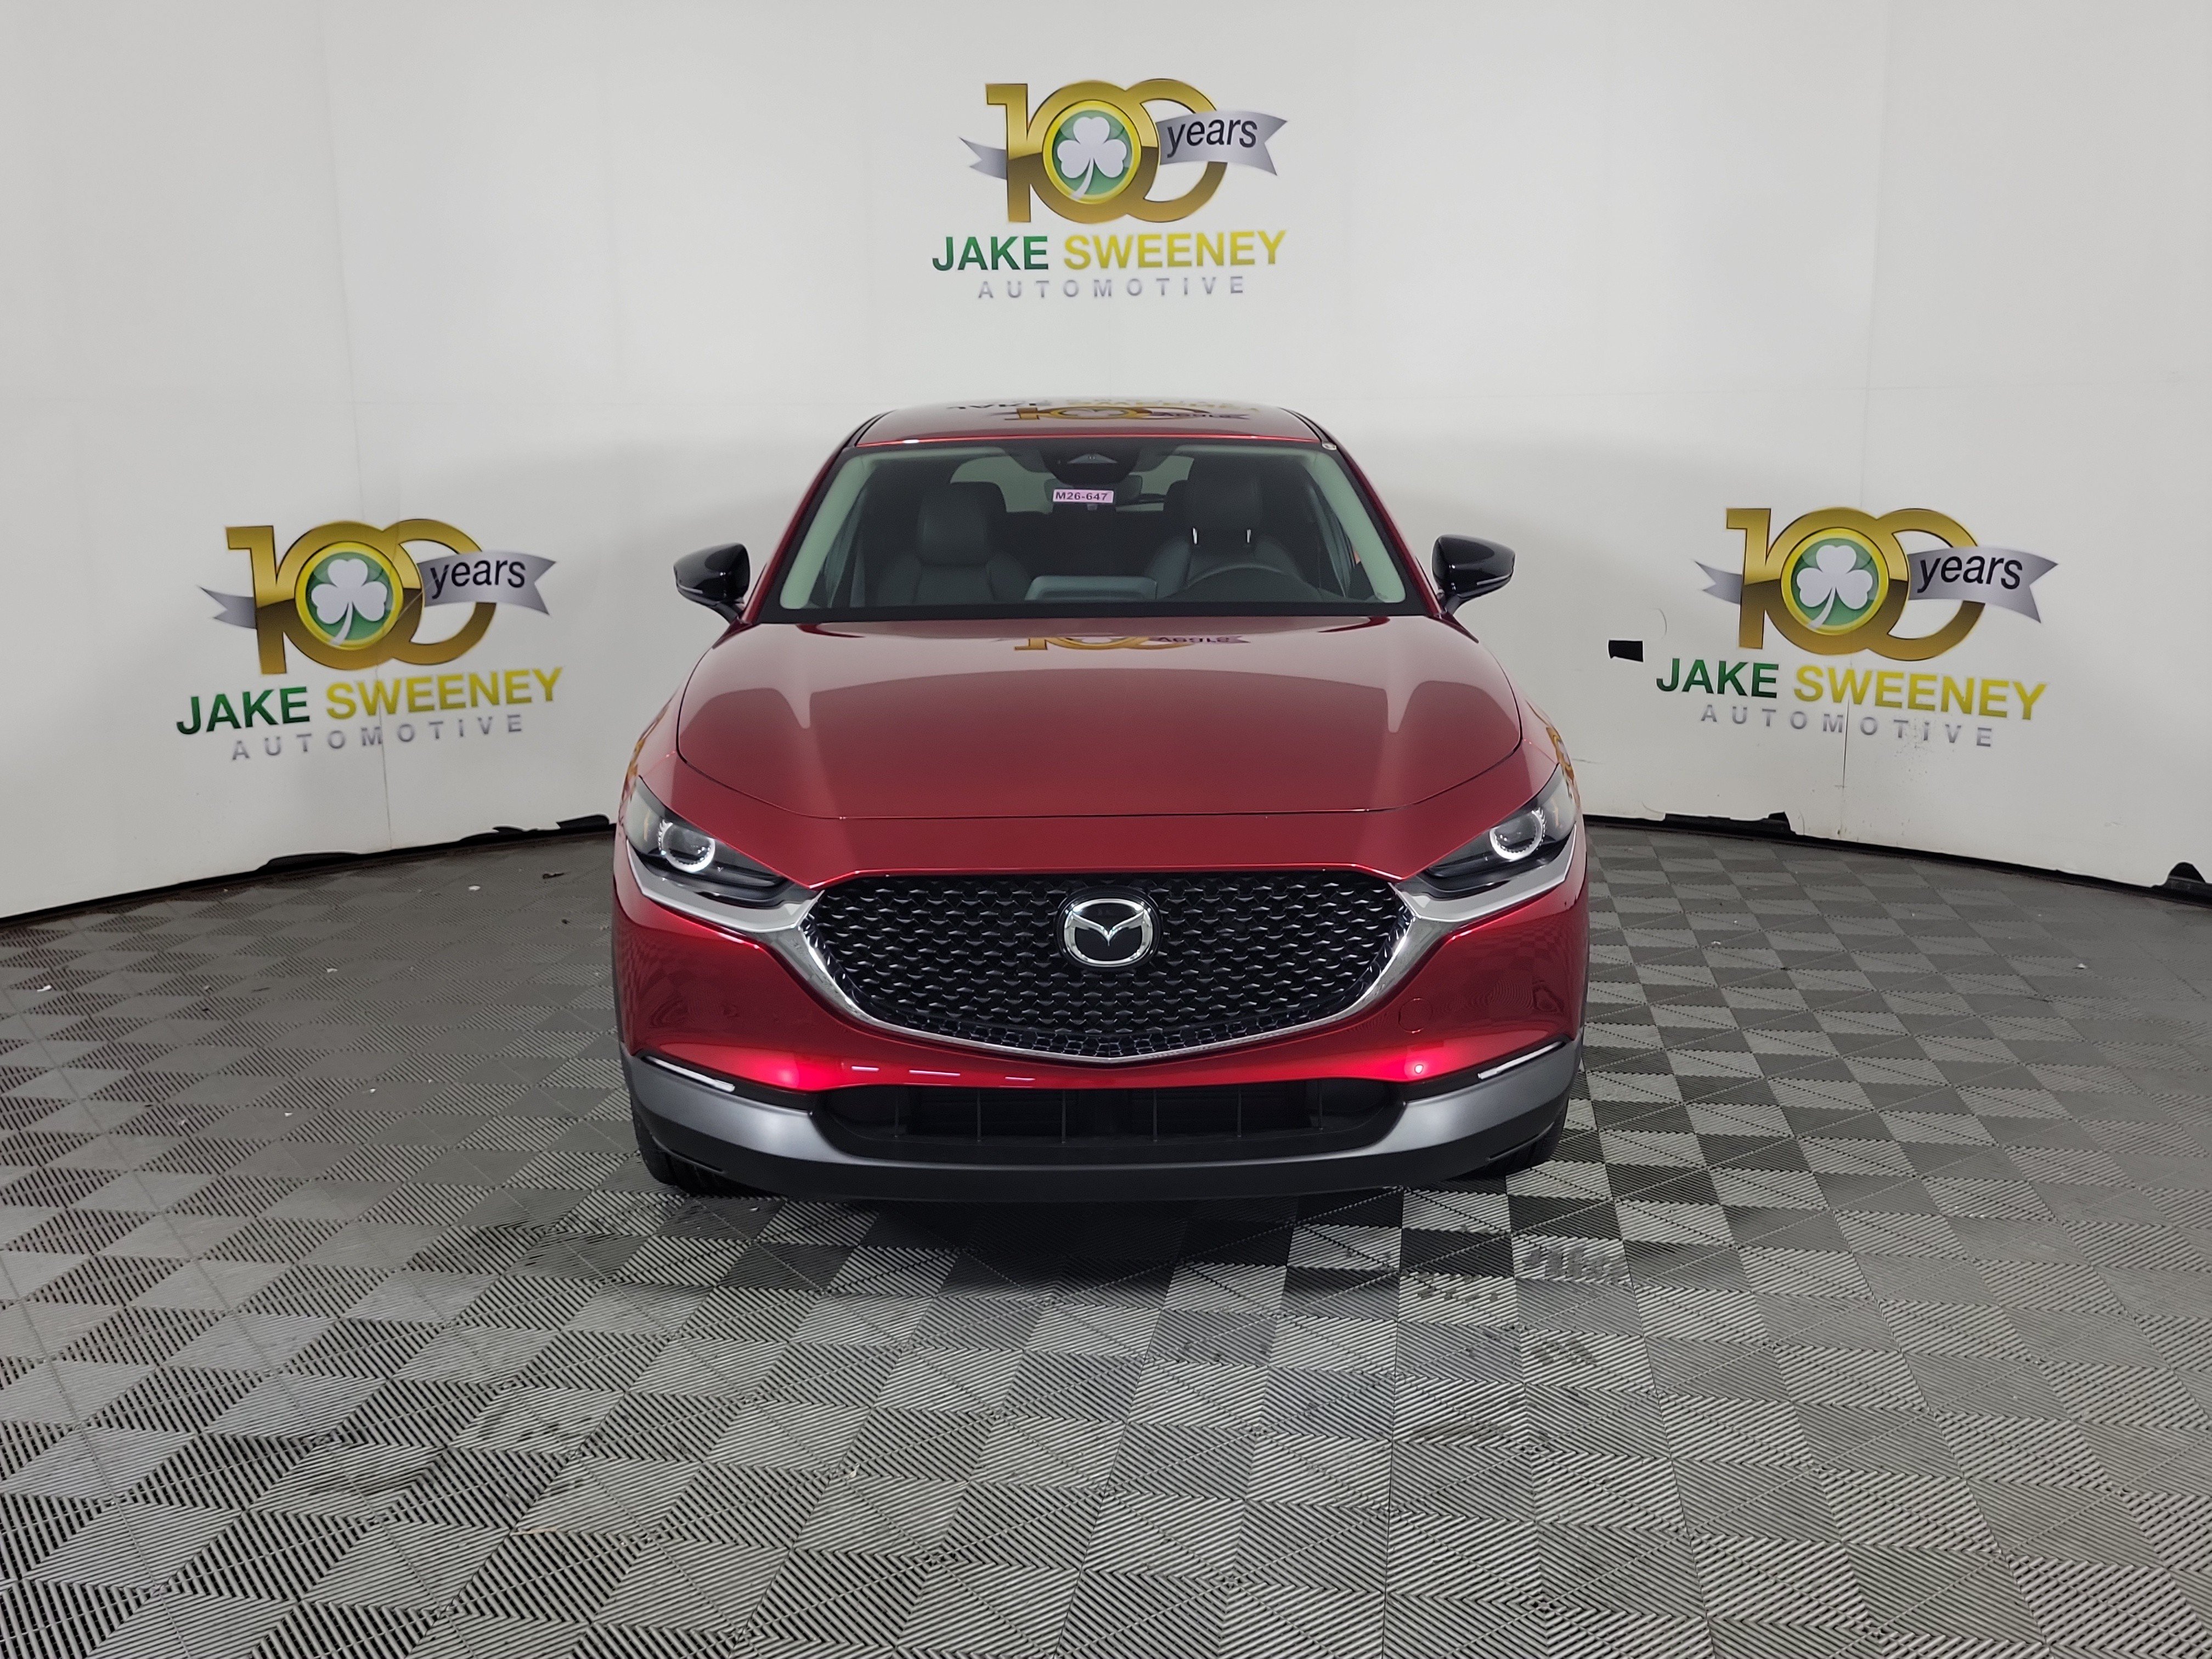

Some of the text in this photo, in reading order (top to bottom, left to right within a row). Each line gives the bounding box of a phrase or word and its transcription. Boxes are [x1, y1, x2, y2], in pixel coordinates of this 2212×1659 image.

[985, 78, 1259, 224] 100 years
[933, 230, 1286, 271] JAKE SWEENEY
[978, 276, 1244, 299] AUTOMOTIVE
[1055, 492, 1108, 500] M26-647
[225, 518, 526, 675] 100 years
[1725, 507, 2023, 661] 100 years
[176, 667, 563, 736] JAKE SWEENEY
[1656, 658, 2047, 721] JAKE SWEENEY
[232, 715, 522, 760] AUTOMOTIVE
[1700, 704, 1993, 748] AUTOMOTIVE
